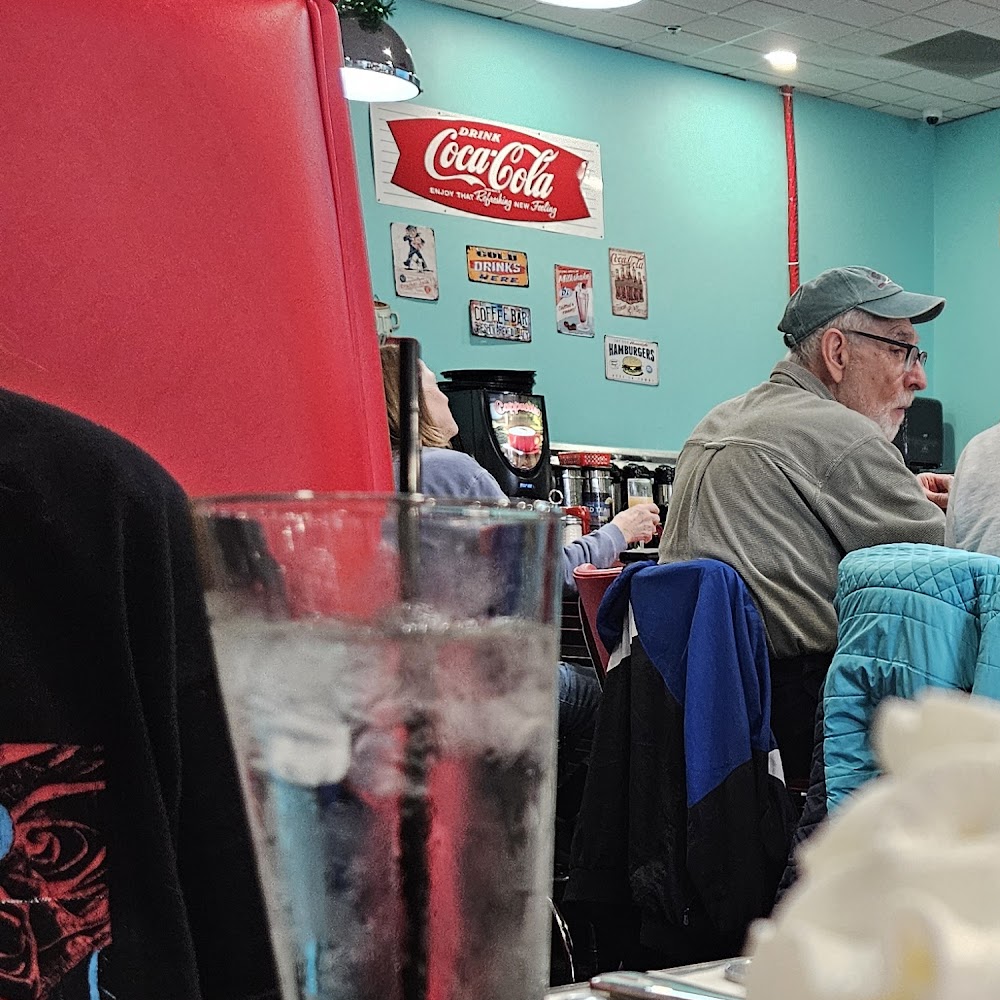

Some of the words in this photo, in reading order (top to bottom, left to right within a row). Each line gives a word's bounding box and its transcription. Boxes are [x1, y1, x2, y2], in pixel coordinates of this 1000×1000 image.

[458, 126, 502, 144] DRINK
[424, 127, 560, 200] Coca-Cola
[429, 186, 454, 198] ENJOY
[455, 191, 475, 201] THAT
[472, 188, 513, 212] Refreshing
[513, 200, 531, 211] NEW
[529, 199, 558, 219] Feeling
[473, 261, 521, 273] DRINKS
[479, 273, 520, 283] HERE
[474, 306, 509, 324] COFFEE
[510, 308, 529, 328] BAR
[608, 343, 655, 362] HAMBURGERS
